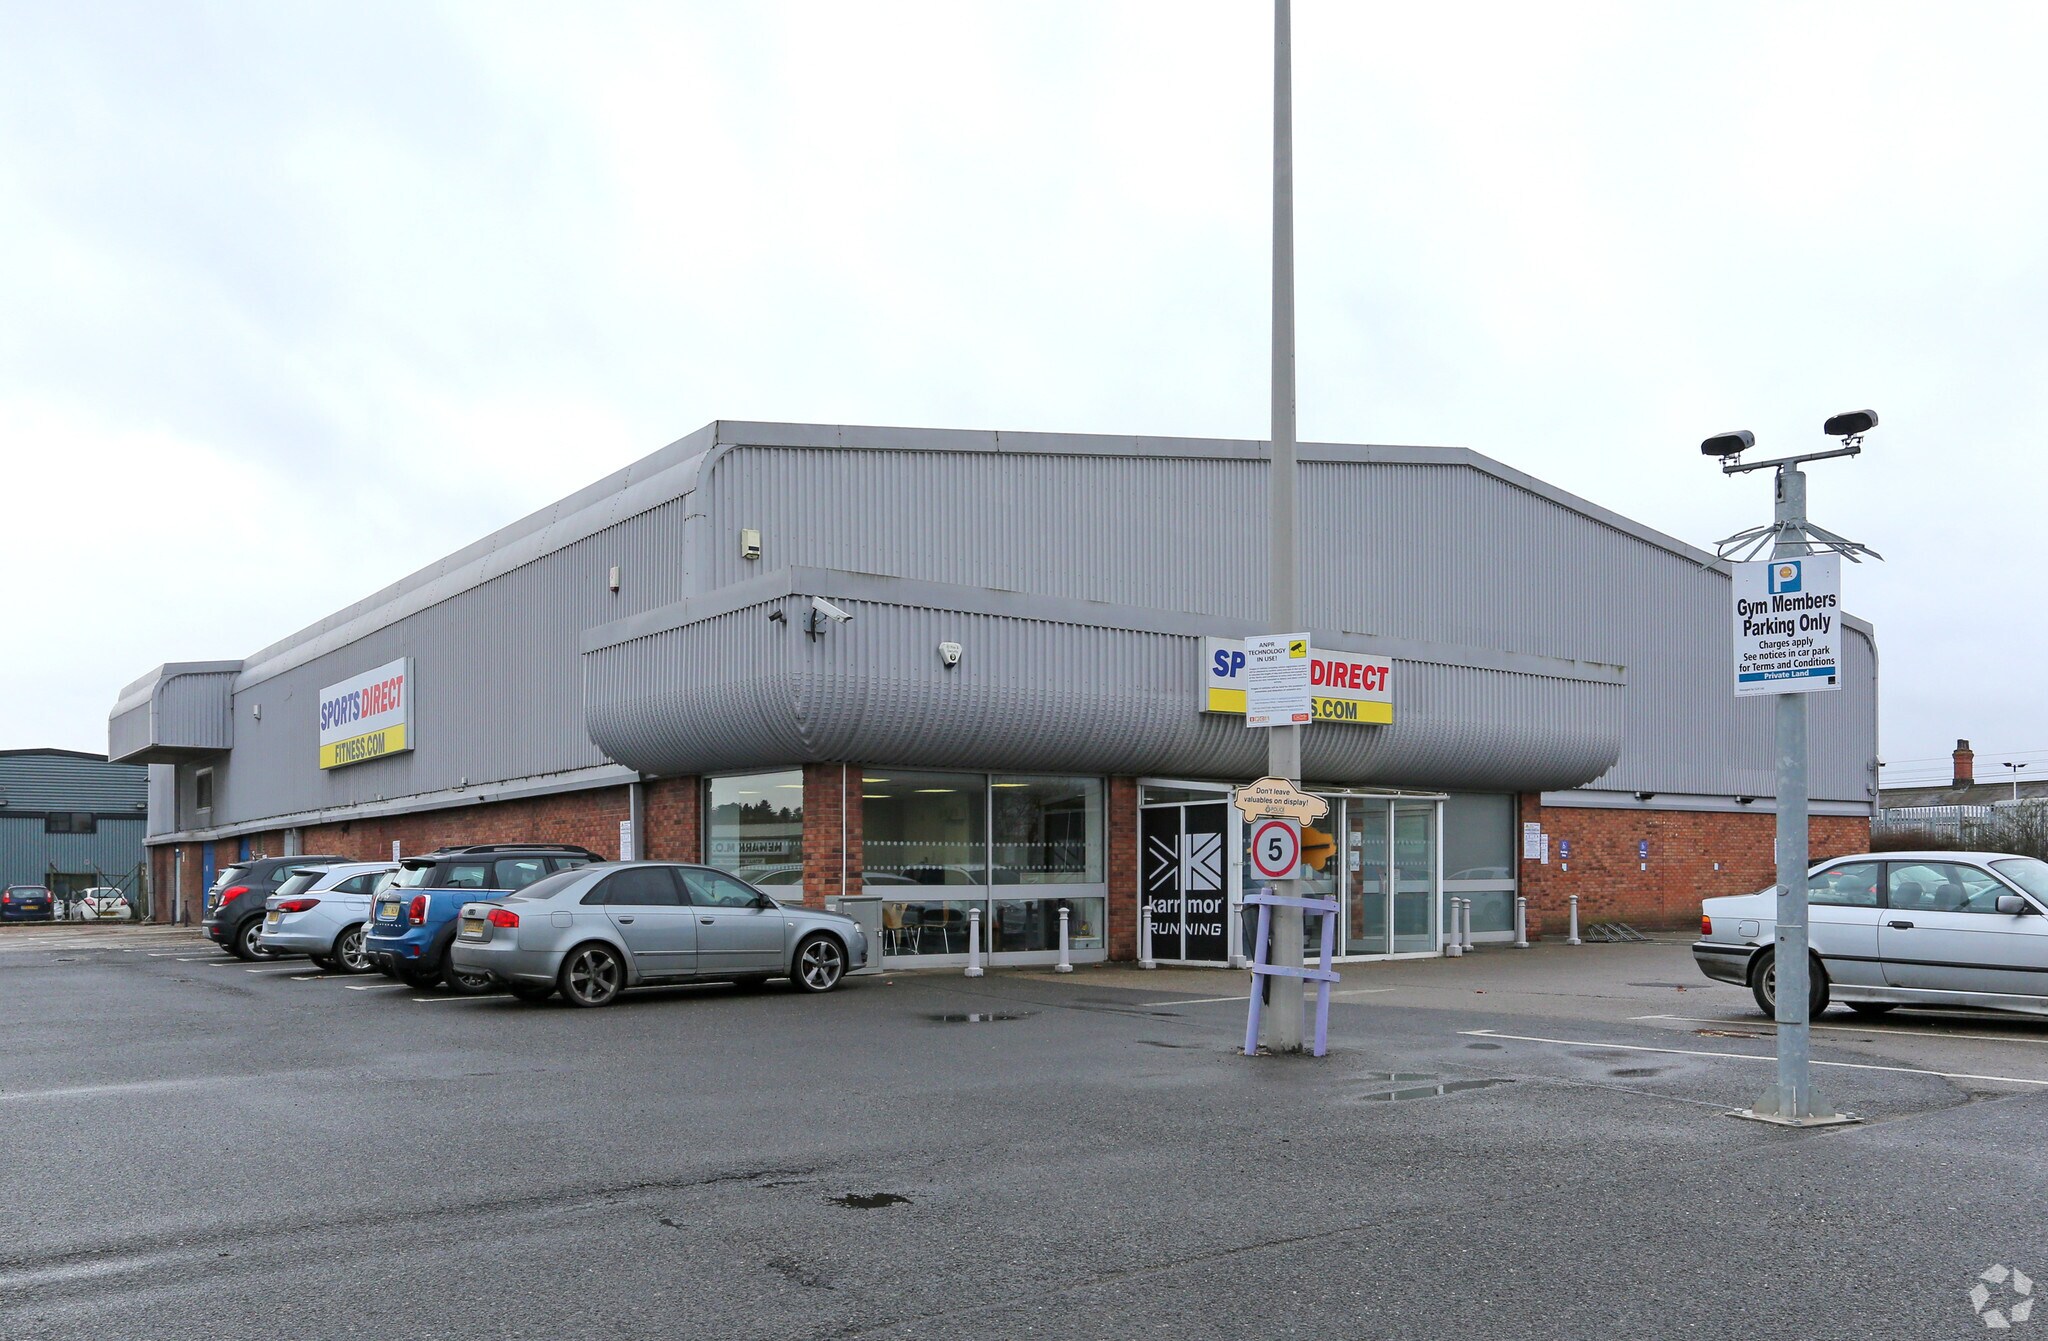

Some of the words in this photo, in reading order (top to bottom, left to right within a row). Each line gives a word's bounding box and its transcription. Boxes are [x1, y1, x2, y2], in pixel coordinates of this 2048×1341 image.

[1737, 598, 1768, 619] Gym
[1772, 592, 1836, 613] Members
[1743, 617, 1795, 637] Parking
[1799, 613, 1831, 634] Only
[1248, 648, 1286, 656] TECHNOLOGY
[1759, 640, 1790, 650] Charges
[1791, 637, 1814, 647] apply
[1743, 652, 1757, 661] See
[1759, 650, 1787, 660] notices
[1788, 649, 1796, 657] in
[1798, 648, 1810, 656] car
[1812, 646, 1830, 657] park
[1739, 663, 1750, 673] for
[1752, 662, 1775, 672] Terms
[1777, 659, 1792, 669] and
[1793, 657, 1835, 668] Conditions
[1310, 659, 1389, 691] DIRECT
[1764, 671, 1790, 679] Private
[1791, 669, 1810, 678] Land
[320, 690, 361, 731] SPORTS
[361, 675, 404, 719] DIRECT
[335, 732, 385, 764] FITNESS.COM
[1256, 787, 1272, 795] Don't
[1273, 788, 1291, 796] leave
[1244, 796, 1273, 804] valuables
[1283, 798, 1309, 807] display!
[1268, 838, 1283, 861] 5
[1148, 895, 1221, 914] karrmor
